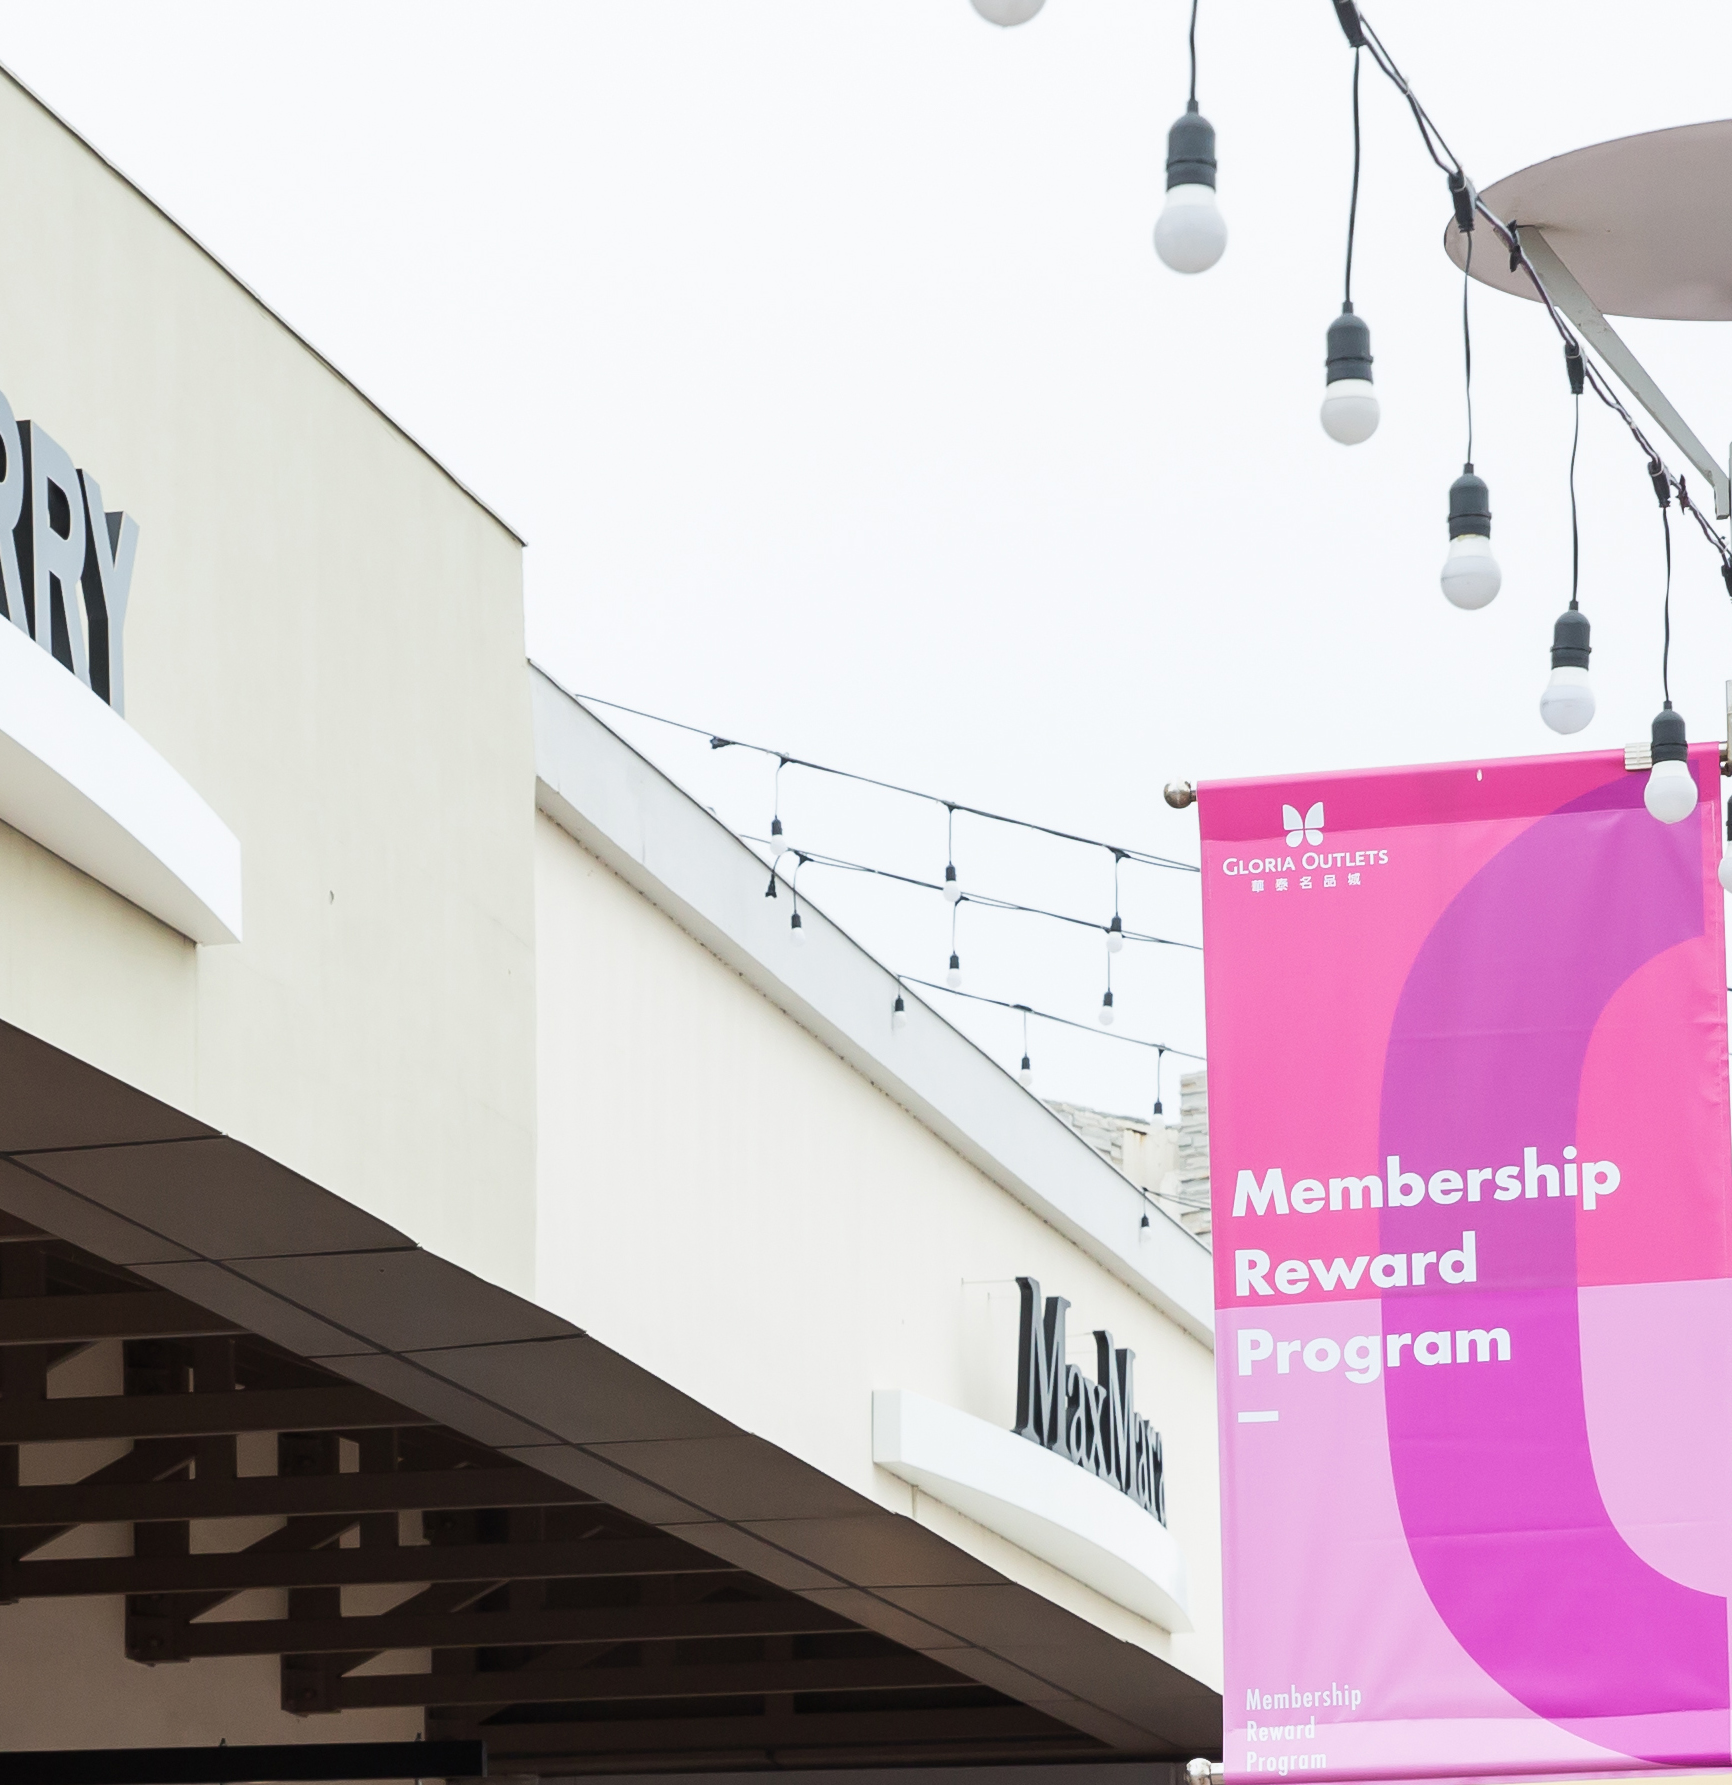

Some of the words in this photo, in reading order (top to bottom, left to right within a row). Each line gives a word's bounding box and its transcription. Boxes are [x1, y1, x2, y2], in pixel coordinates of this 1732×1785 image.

[1223, 858, 1296, 876] GLORIA
[1302, 850, 1389, 870] OUTLETS
[1251, 873, 1361, 893] 華泰名品城
[1232, 1146, 1621, 1218] Membership
[1234, 1230, 1477, 1297] Reward
[1237, 1327, 1511, 1384] Program
[1011, 1276, 1167, 1528] MaxMara
[1245, 1681, 1362, 1711] Membership
[1246, 1715, 1315, 1742] Reward
[1246, 1750, 1327, 1777] Program
